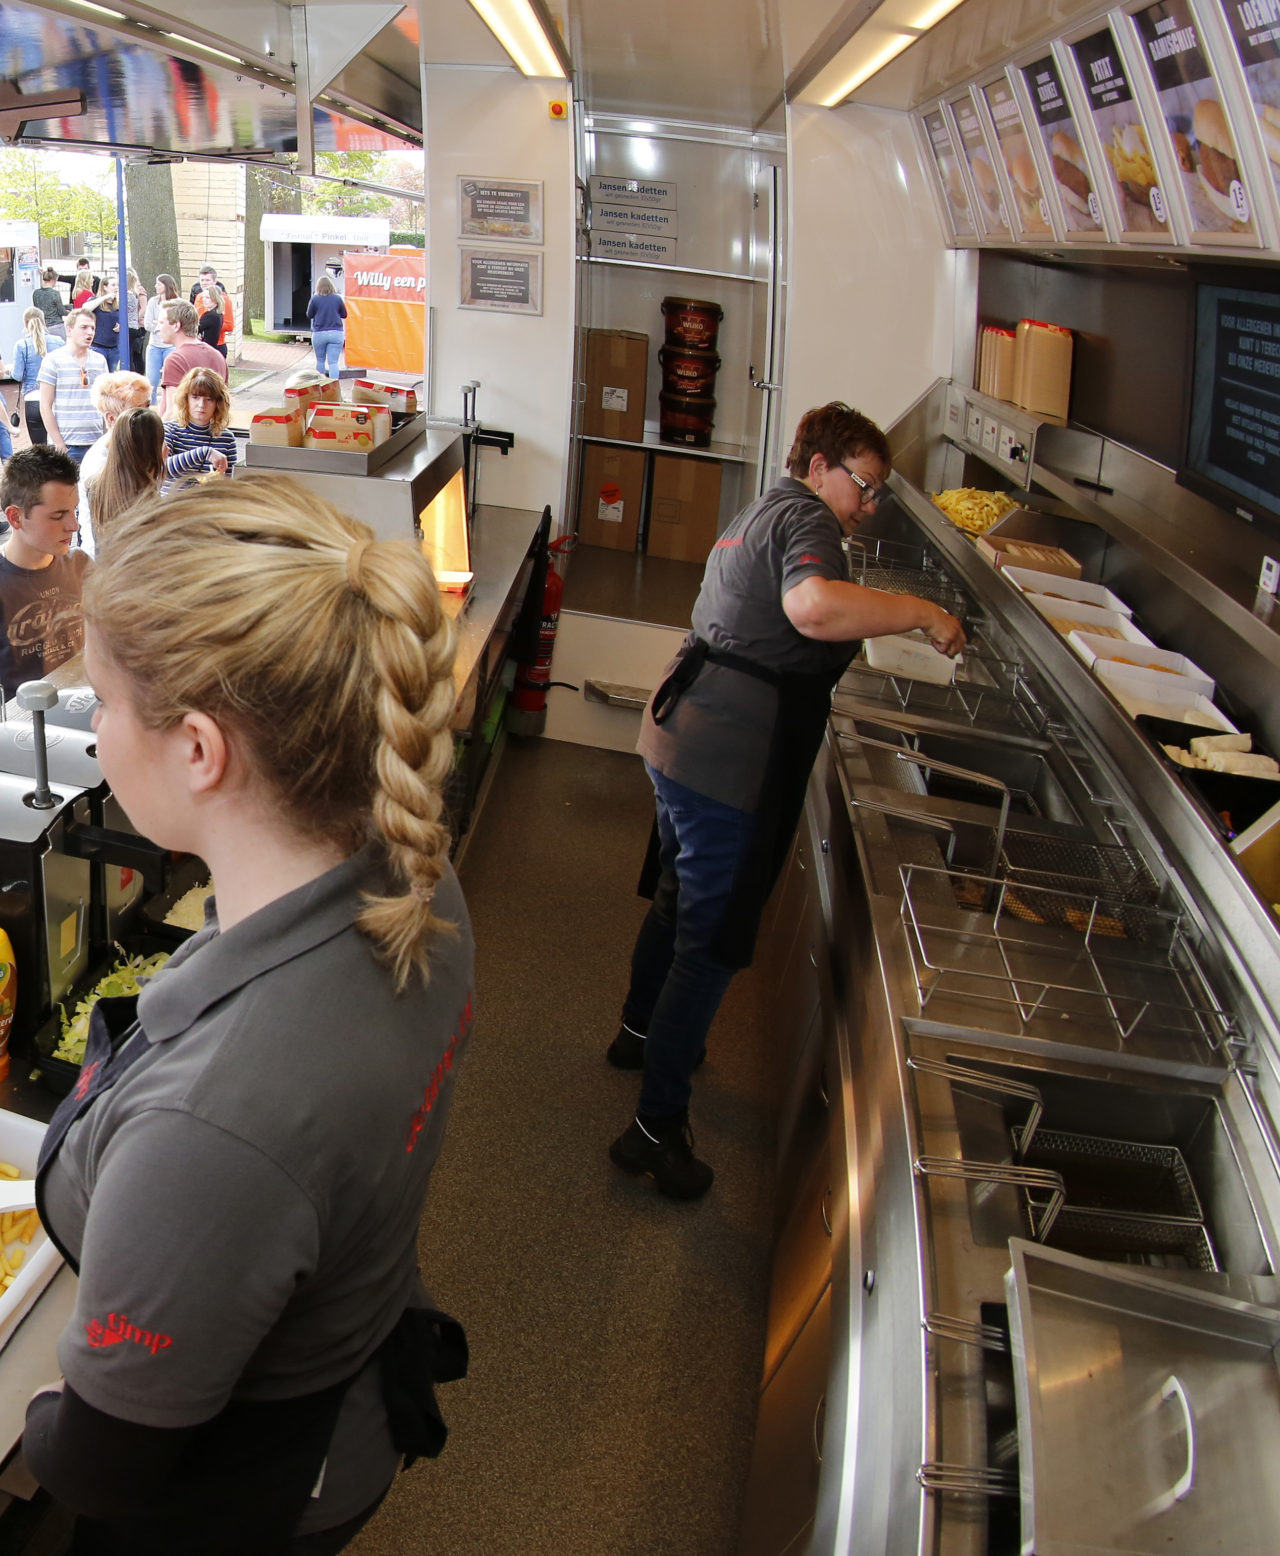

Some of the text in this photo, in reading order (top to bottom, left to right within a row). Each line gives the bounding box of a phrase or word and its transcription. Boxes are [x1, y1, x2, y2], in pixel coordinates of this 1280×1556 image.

[1090, 56, 1113, 83] PATAT
[598, 181, 667, 196] Jansen adetten
[600, 209, 669, 223] Jansen kadetten
[598, 237, 667, 253] Jansen kadetten
[353, 271, 392, 291] Willy
[394, 276, 416, 288] een
[1236, 317, 1272, 336] ALLERGENEN
[1237, 354, 1253, 371] ONZE
